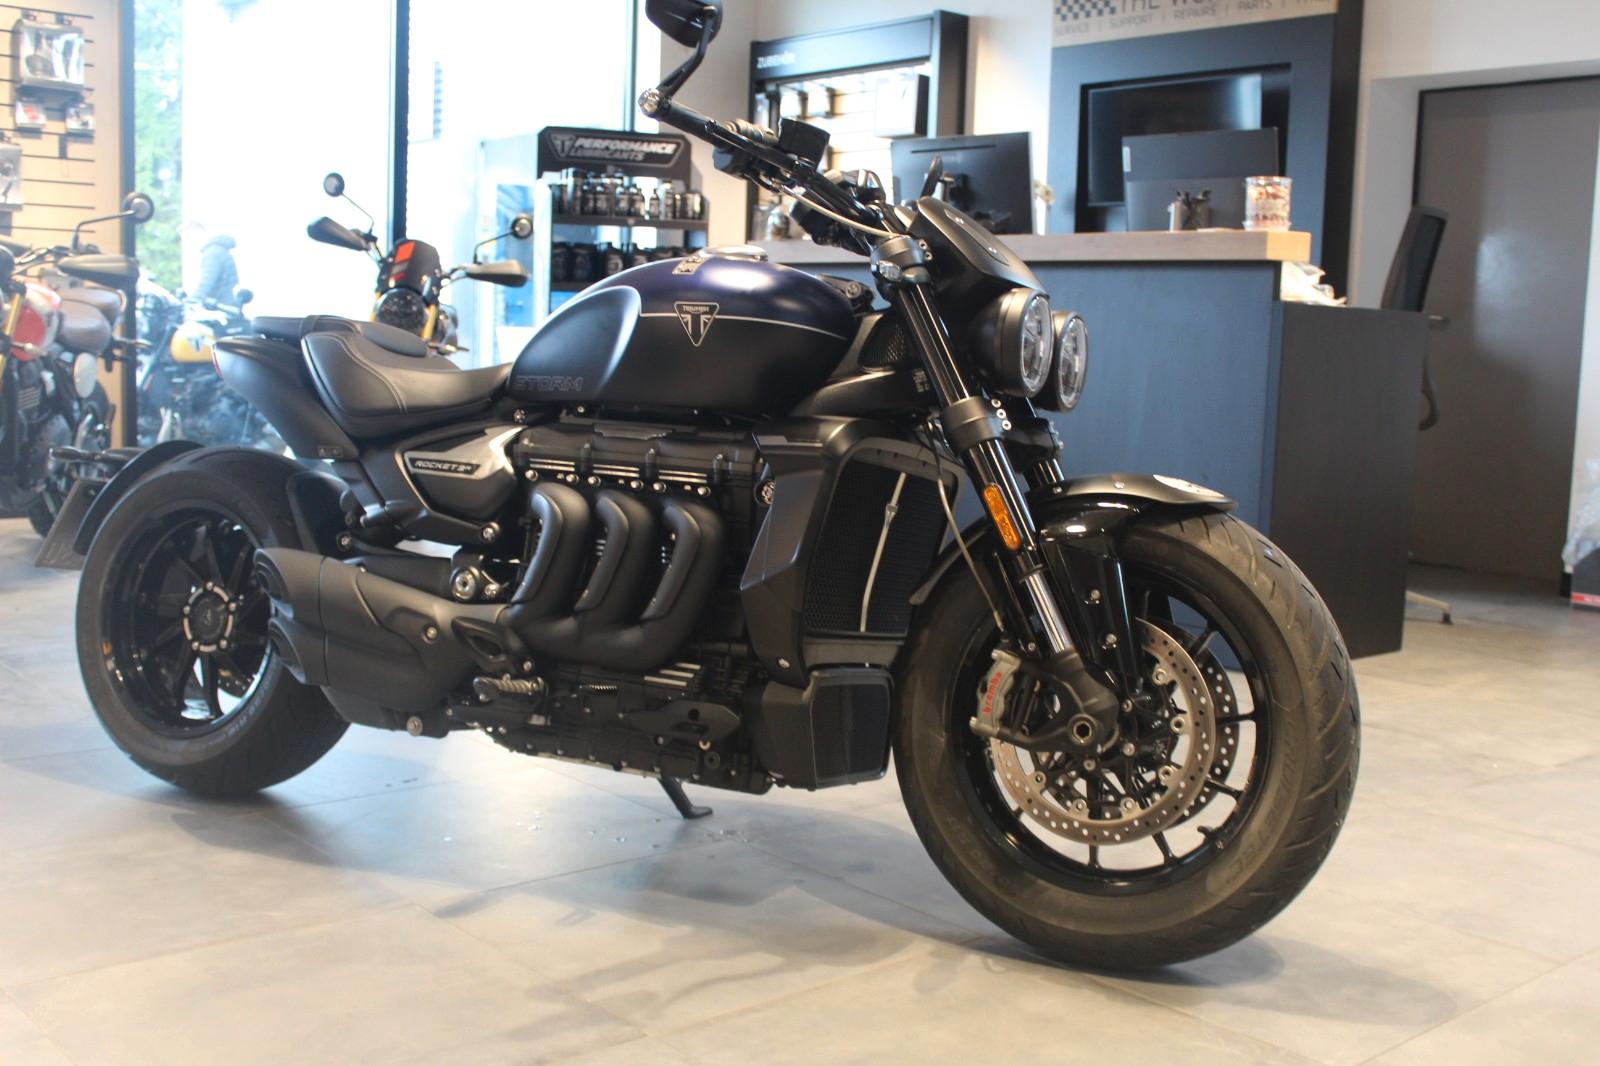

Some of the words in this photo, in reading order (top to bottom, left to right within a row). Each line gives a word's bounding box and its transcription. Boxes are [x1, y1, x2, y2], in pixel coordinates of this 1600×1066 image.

[1109, 14, 1153, 29] SUPPORT
[1173, 7, 1217, 21] REPAIRS
[574, 137, 678, 154] PERFORMANCE
[569, 148, 646, 161] LUBRICANTS
[682, 305, 710, 313] TRIUMPH
[512, 375, 584, 392] STORM
[982, 671, 1002, 715] brembo
